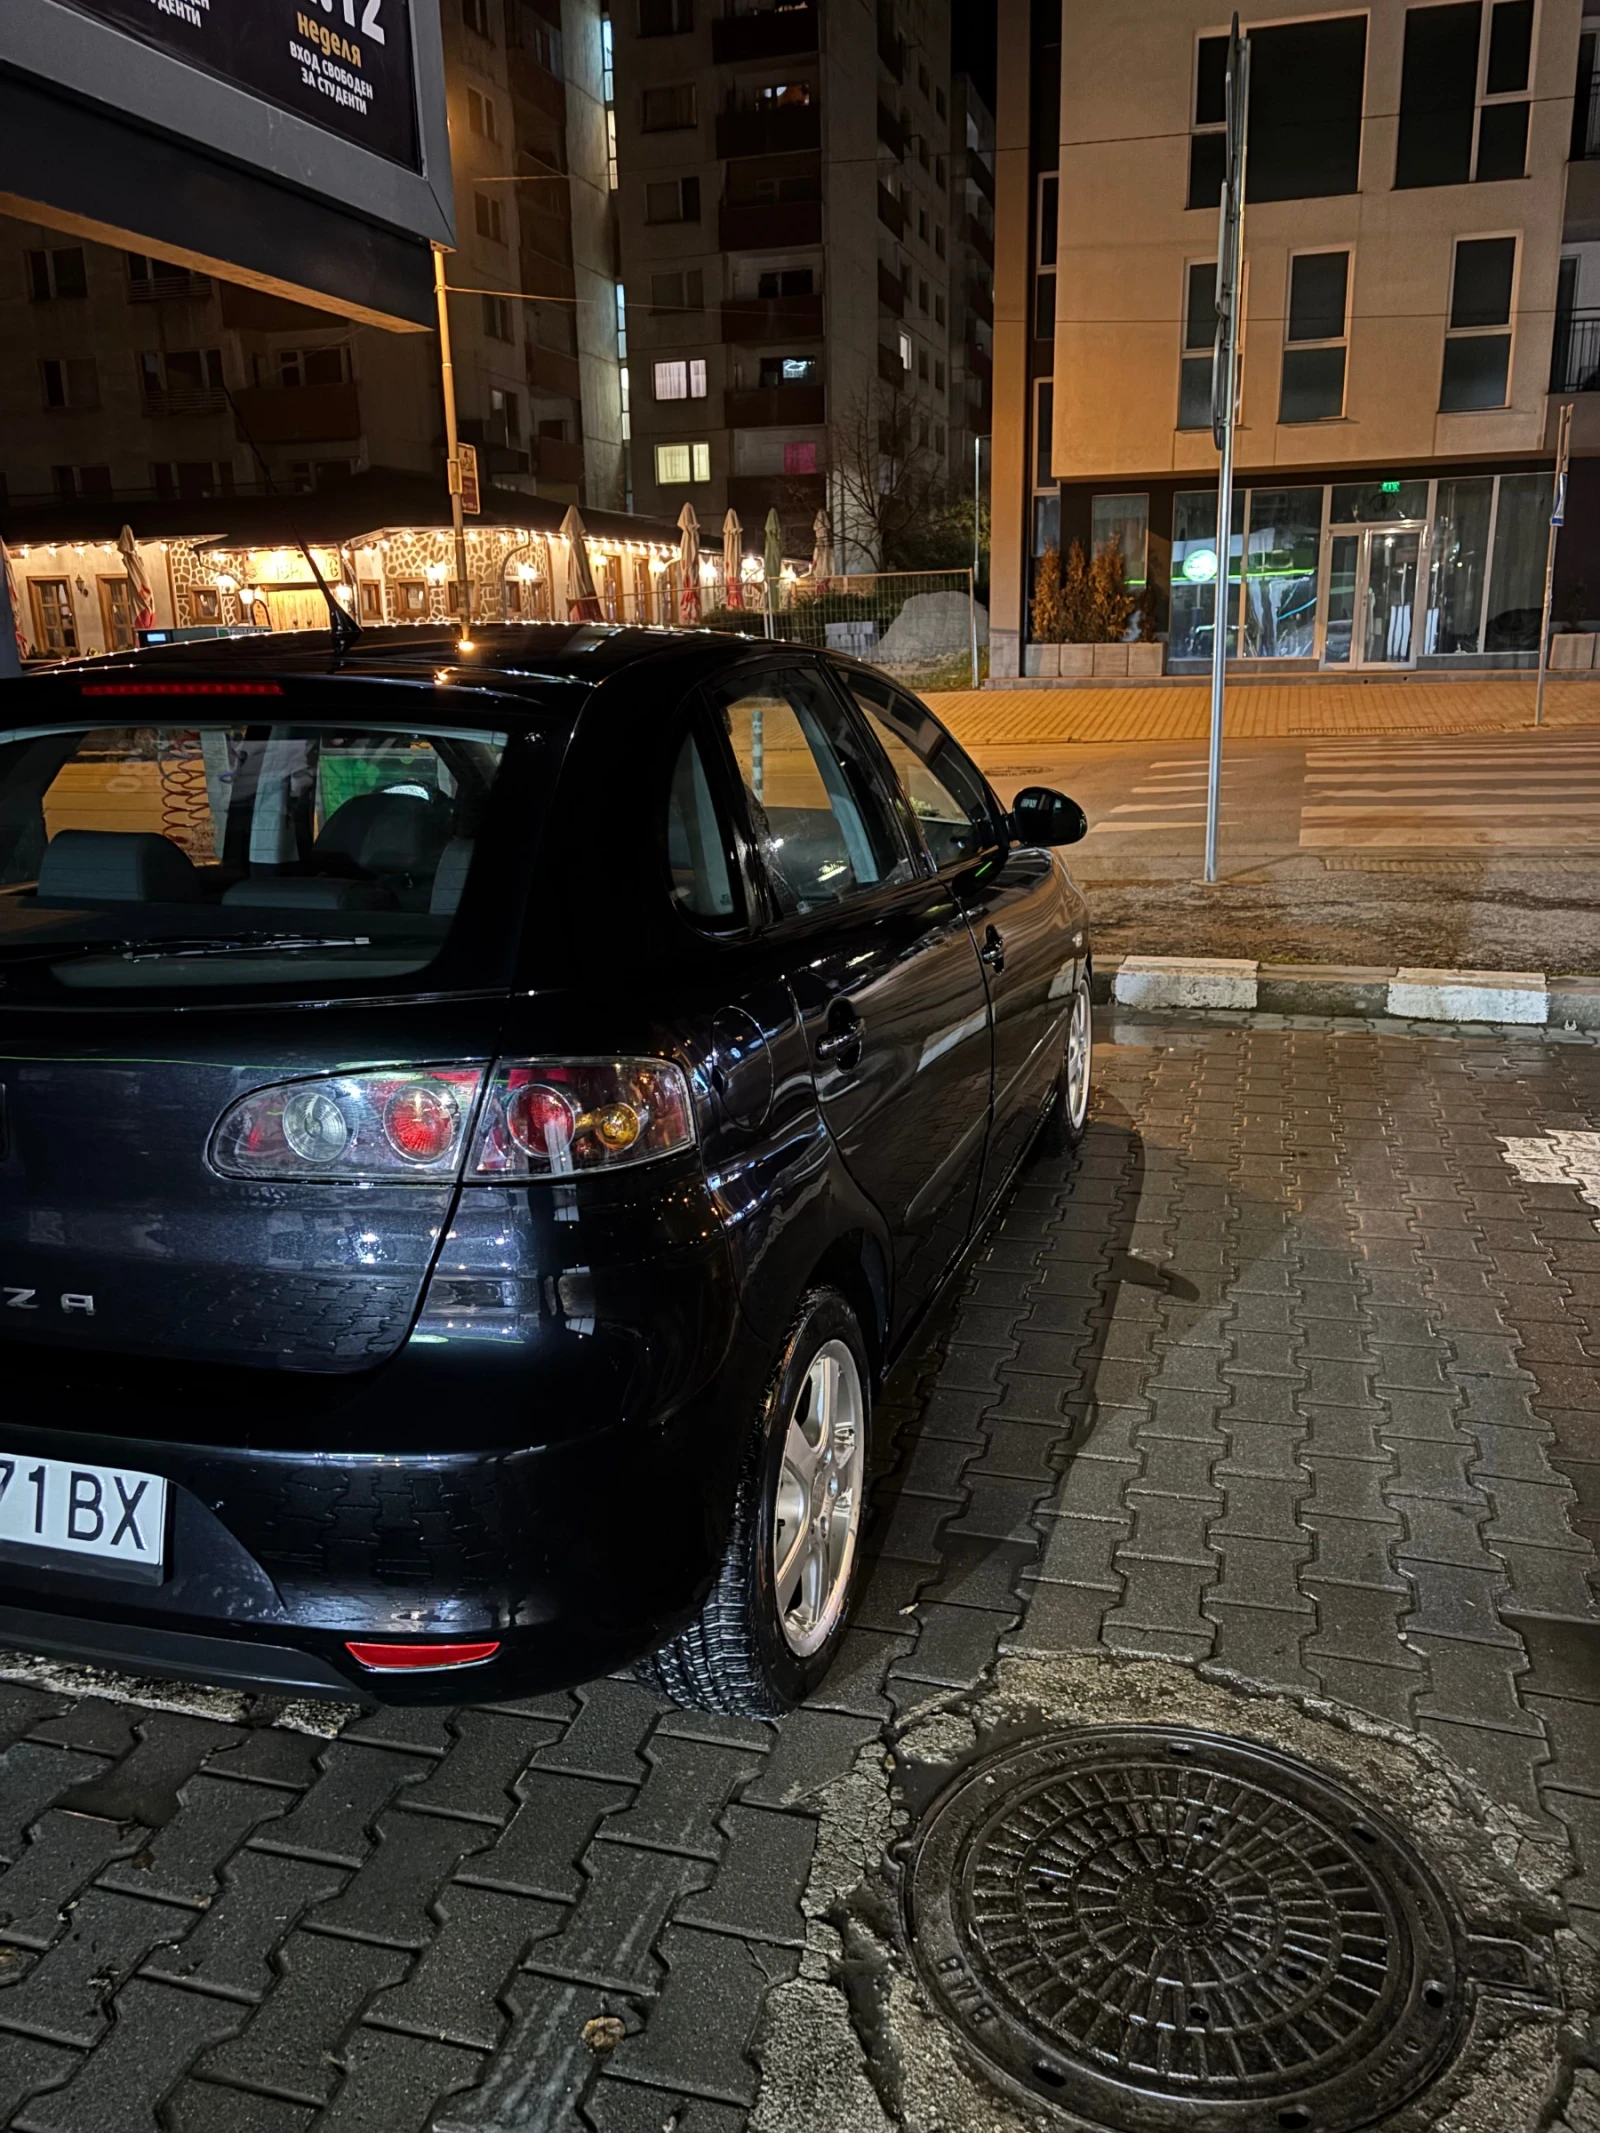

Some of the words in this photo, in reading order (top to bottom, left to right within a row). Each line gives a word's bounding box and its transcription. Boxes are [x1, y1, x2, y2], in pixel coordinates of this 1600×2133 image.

[150, 0, 201, 28] ДЕНТИ
[297, 11, 361, 68] неделя
[289, 40, 321, 74] ВХОД
[321, 59, 373, 100] СВОБОДЕН
[301, 67, 316, 88] ЗА
[317, 76, 367, 115] СТУДЕНТИ
